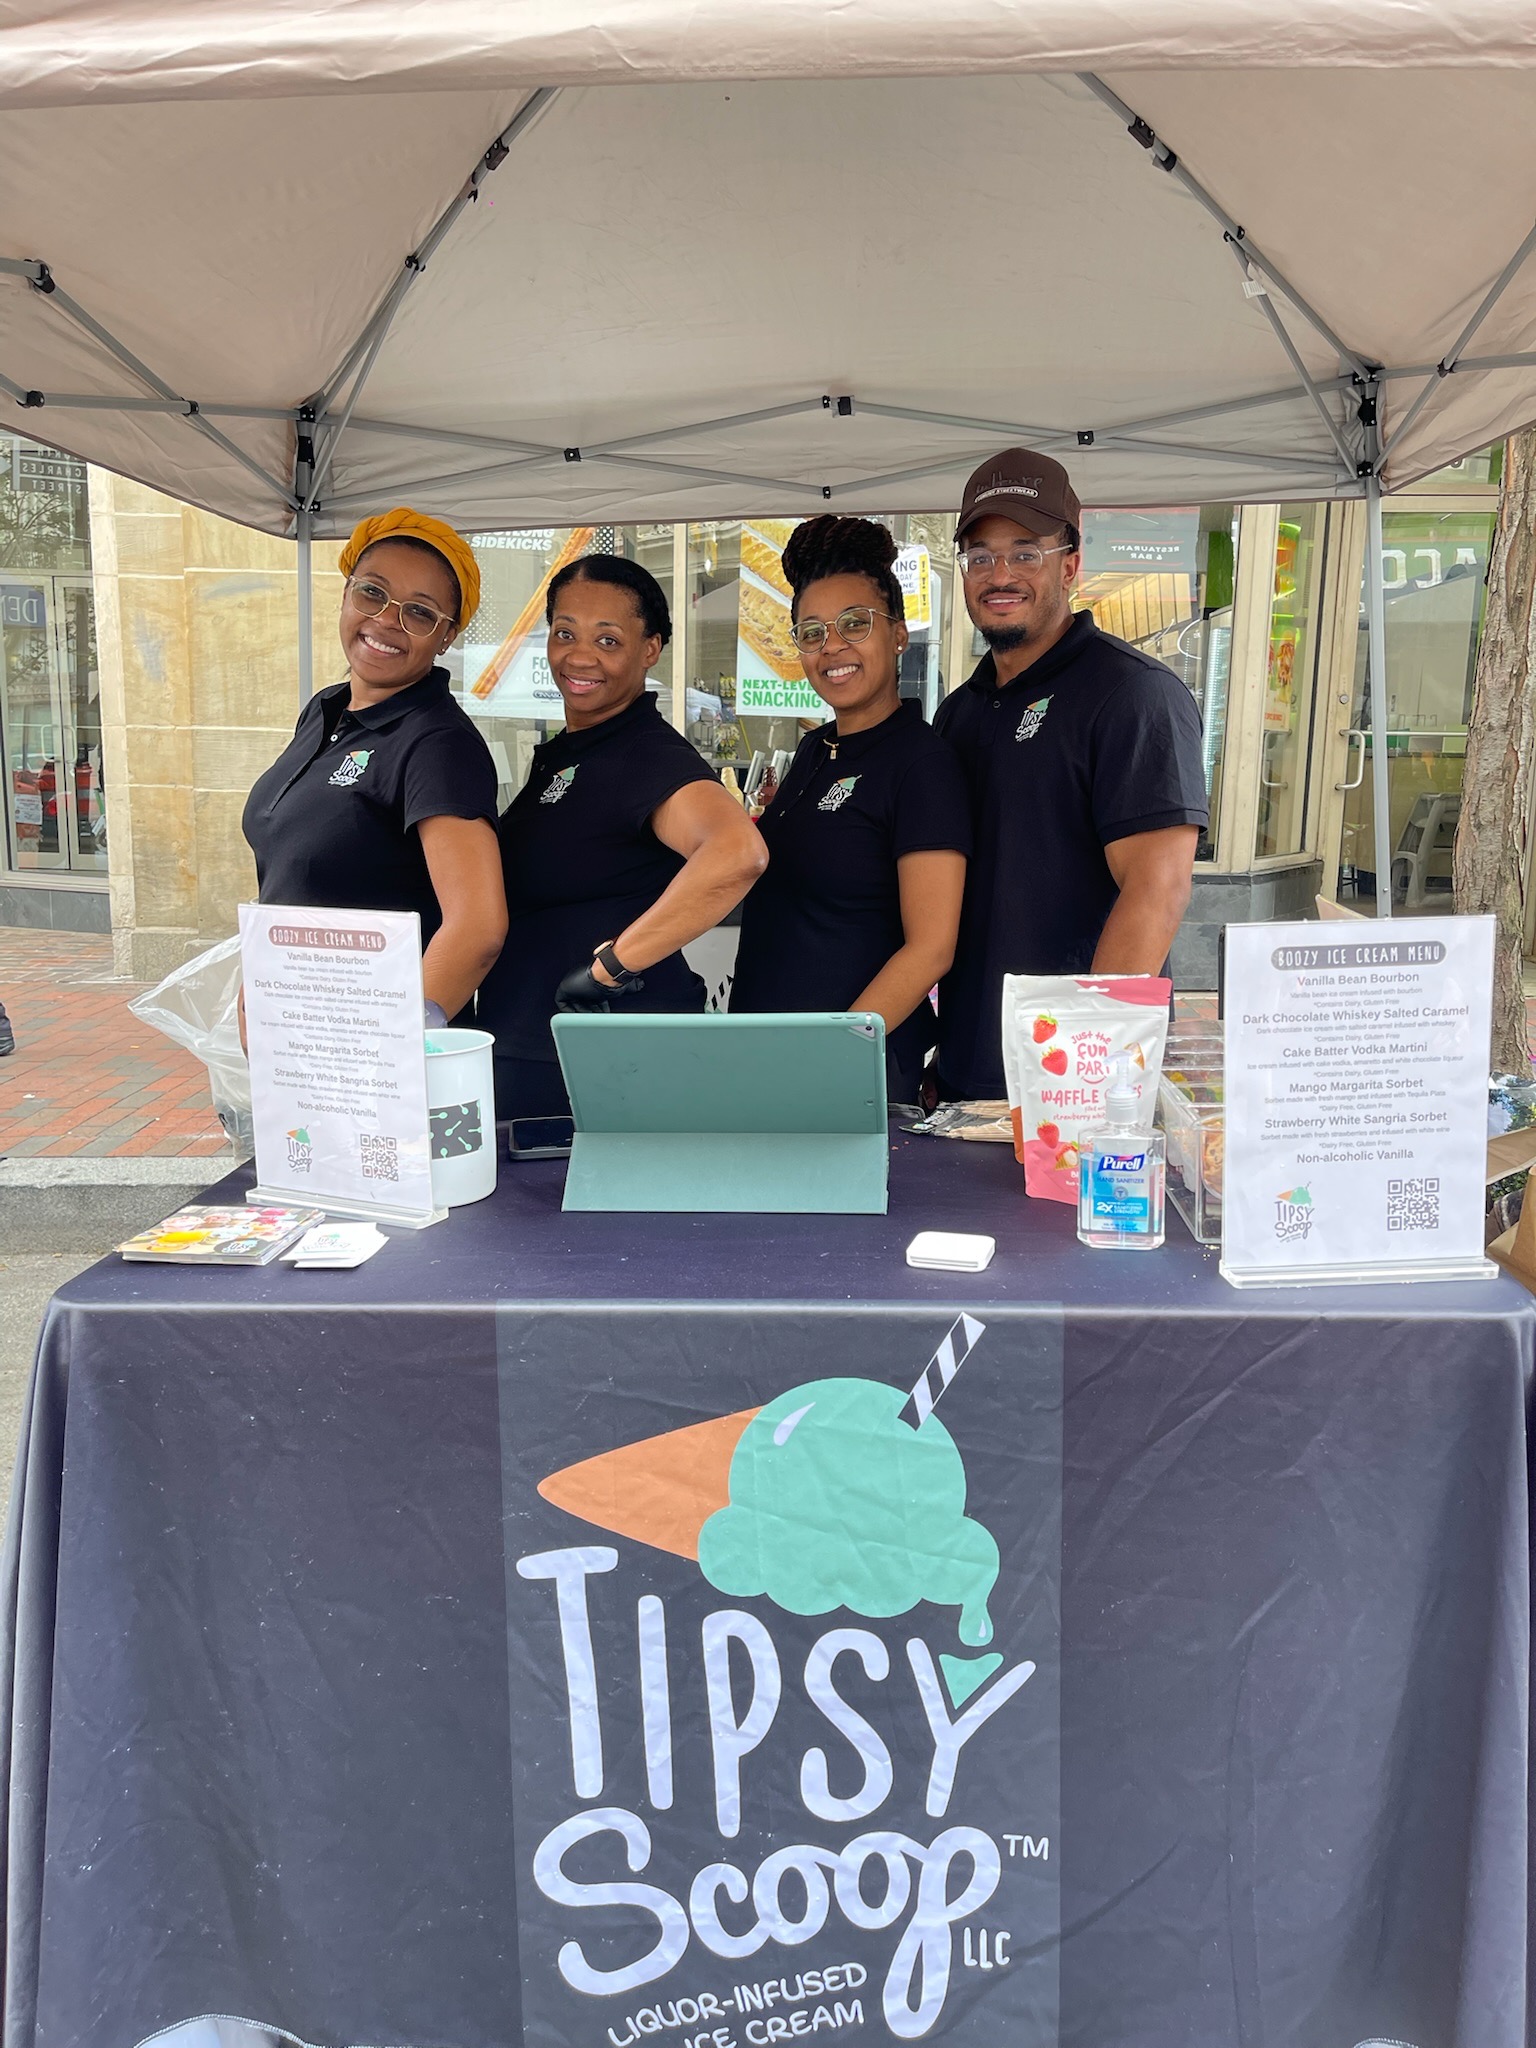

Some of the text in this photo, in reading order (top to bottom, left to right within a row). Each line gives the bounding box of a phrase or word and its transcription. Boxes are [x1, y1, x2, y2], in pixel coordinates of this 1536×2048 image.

[471, 536, 553, 551] SIDEKICKS
[895, 560, 917, 572] ING
[742, 690, 822, 708] SNACKING
[272, 929, 382, 949] BOOZY ICE CREAM MENU
[287, 952, 370, 966] Vanilla Bean Bourbon
[1278, 945, 1440, 966] BOOZY ICE CREAM MENU
[1297, 972, 1419, 987] Vanilla Bean Bourbon
[255, 979, 406, 999] Dark Chocolate Whiskey Salted Caramel
[282, 1011, 380, 1027] Cake Batter Vodka Martini
[1243, 1006, 1469, 1024] Dark Chocolate Whiskey Salted Caramel
[1071, 1031, 1111, 1044] Just the
[288, 1041, 379, 1058] Mango Margarita Sorbet
[1283, 1042, 1428, 1058] Cake Batter Vodka Martini
[274, 1068, 315, 1082] Strawberry
[315, 1073, 338, 1083] White
[339, 1075, 370, 1087] Sangria
[371, 1078, 398, 1089] Sorbet
[1289, 1078, 1423, 1094] Mango Margarita Sorbet
[1041, 1088, 1099, 1108] WAFFLE
[297, 1101, 377, 1118] Non-alcoholic Vanilla
[1264, 1112, 1447, 1129] Strawberry White Sangria Sorbet
[286, 1137, 313, 1157] TIPSY
[288, 1155, 312, 1172] Scoop
[1296, 1149, 1414, 1163] Non-alcoholic Vanilla
[1274, 1201, 1315, 1223] TIPSY
[1275, 1222, 1312, 1239] Scoop
[516, 1546, 1036, 1838] TIPSY
[533, 1807, 1001, 2038] Scoop
[964, 1927, 1011, 1969] LLC
[608, 1962, 867, 2047] LIQUOR-INFUSED
[746, 1999, 865, 2044] CREAM
